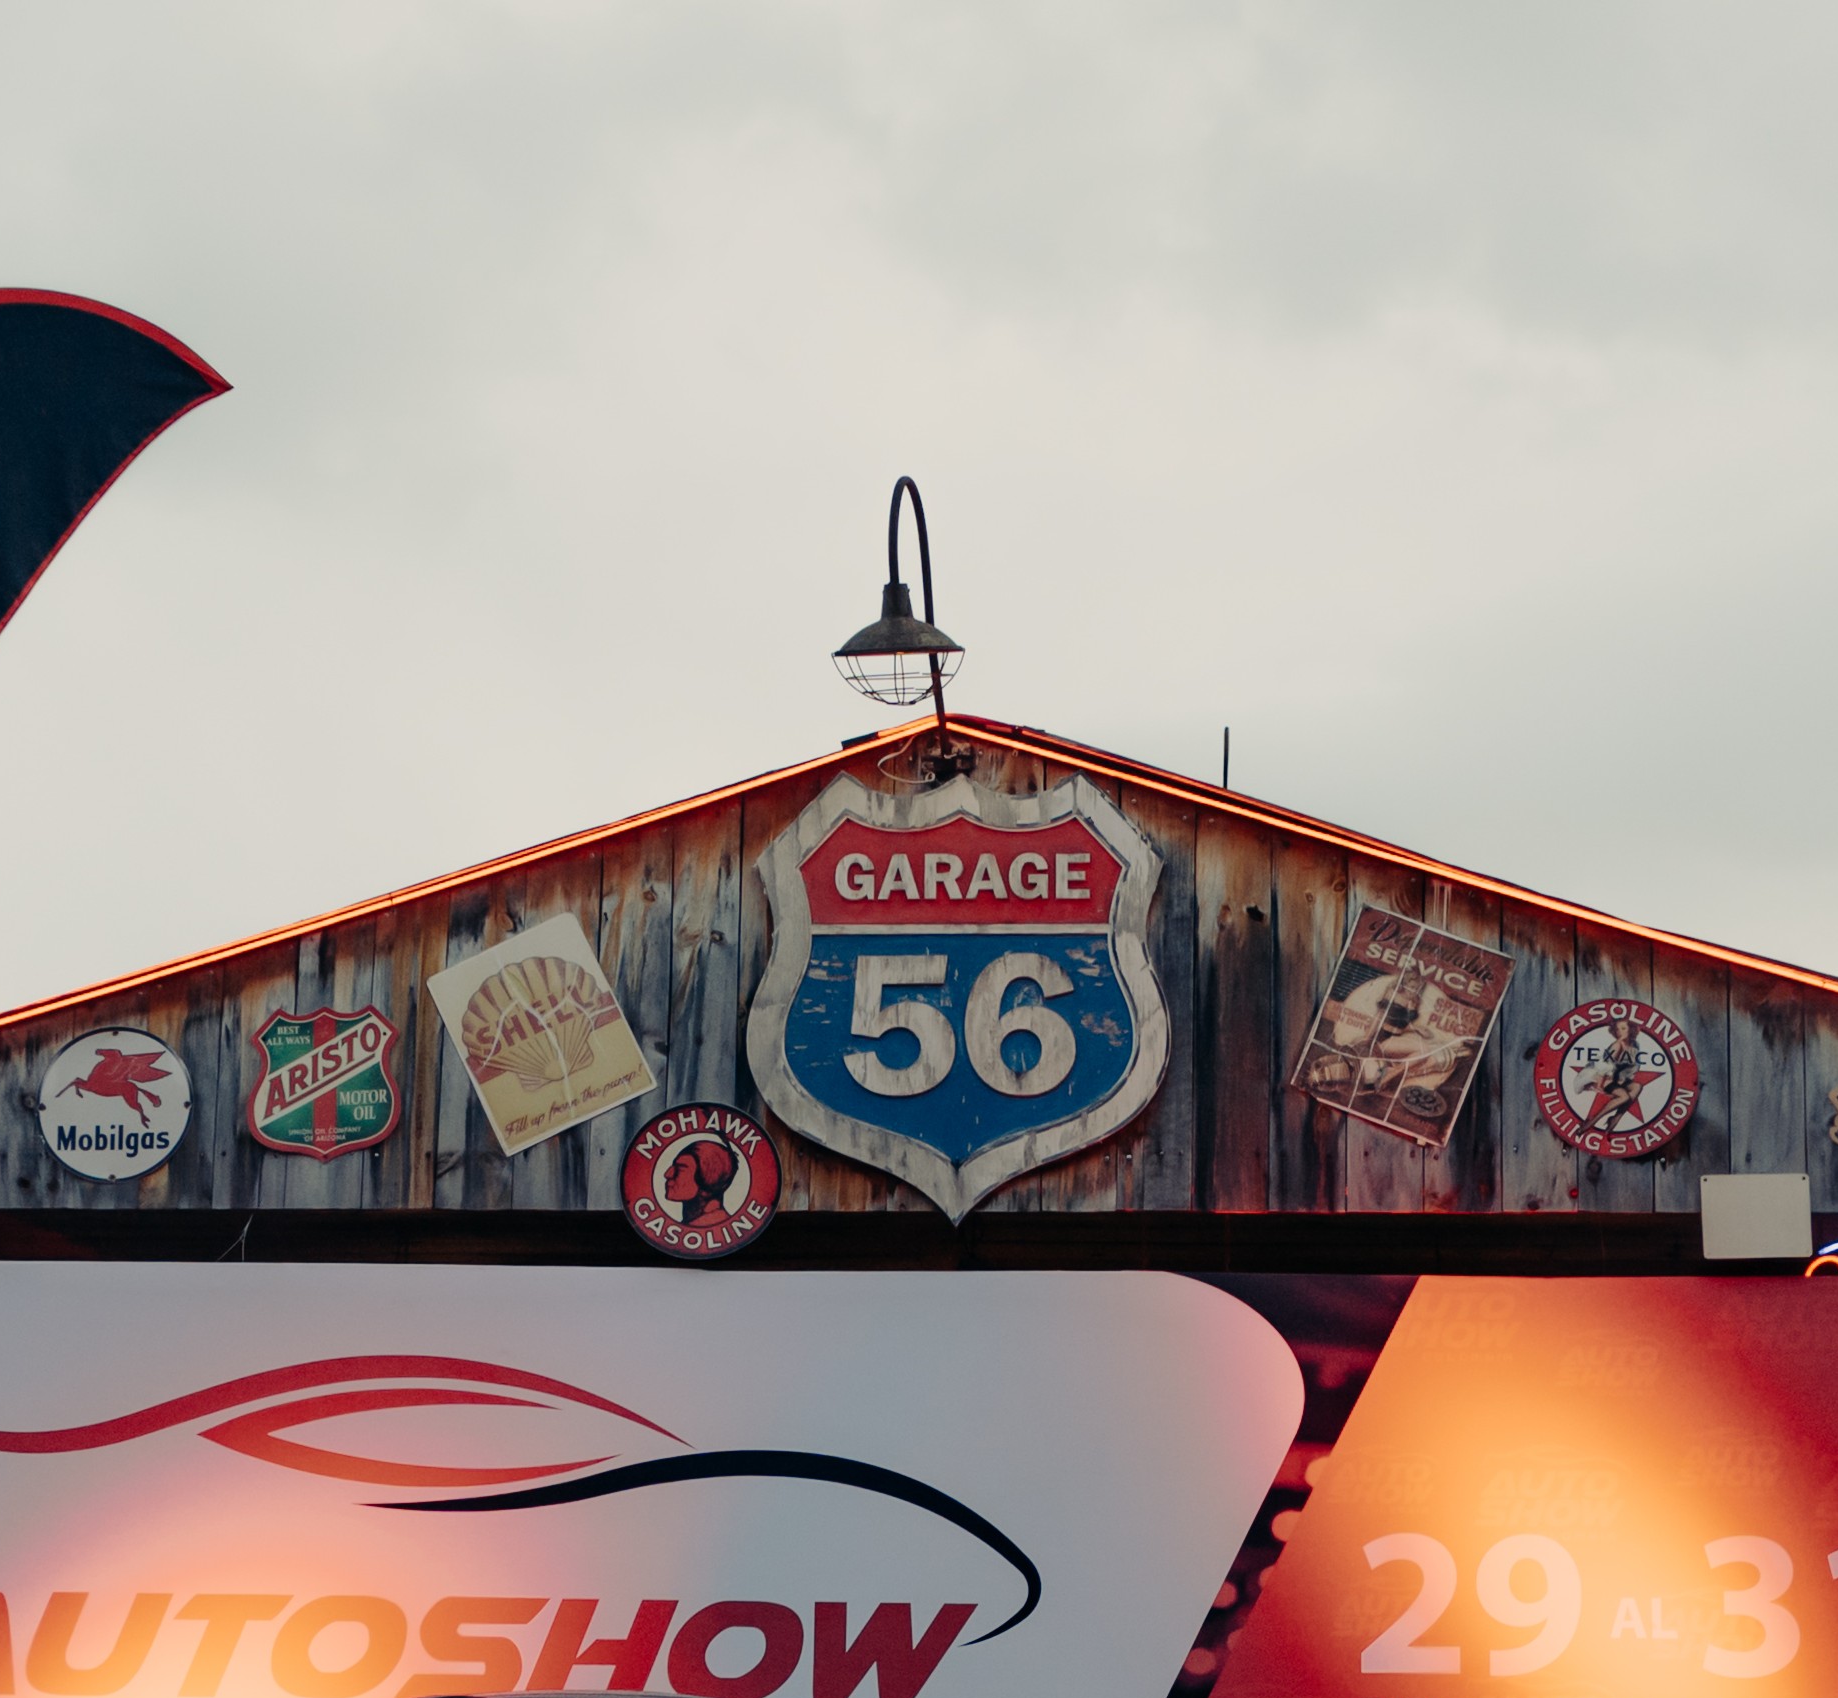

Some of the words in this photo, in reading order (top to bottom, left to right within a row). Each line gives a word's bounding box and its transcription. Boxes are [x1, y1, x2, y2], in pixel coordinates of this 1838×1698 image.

[834, 853, 1091, 900] GARAGE
[1365, 944, 1484, 997] SERVICE
[266, 1037, 283, 1046] ALL
[285, 1035, 311, 1045] WAYS
[277, 1025, 300, 1035] BEST
[476, 985, 595, 1058] SHELL
[843, 952, 1076, 1097] 56
[1548, 1003, 1692, 1064] GASOLINE
[262, 1022, 381, 1120] ARISTO
[1573, 1046, 1666, 1067] TEXACO
[339, 1089, 388, 1105] MOTOR
[353, 1105, 376, 1121] OIL
[1539, 1078, 1603, 1151] FILLING
[1609, 1088, 1694, 1154] STATION
[57, 1125, 170, 1158] Mobilgas
[636, 1110, 762, 1160] MOHAWK
[634, 1198, 768, 1250] GASOLINE
[1361, 1532, 1582, 1677] 29
[1611, 1598, 1679, 1640] AL
